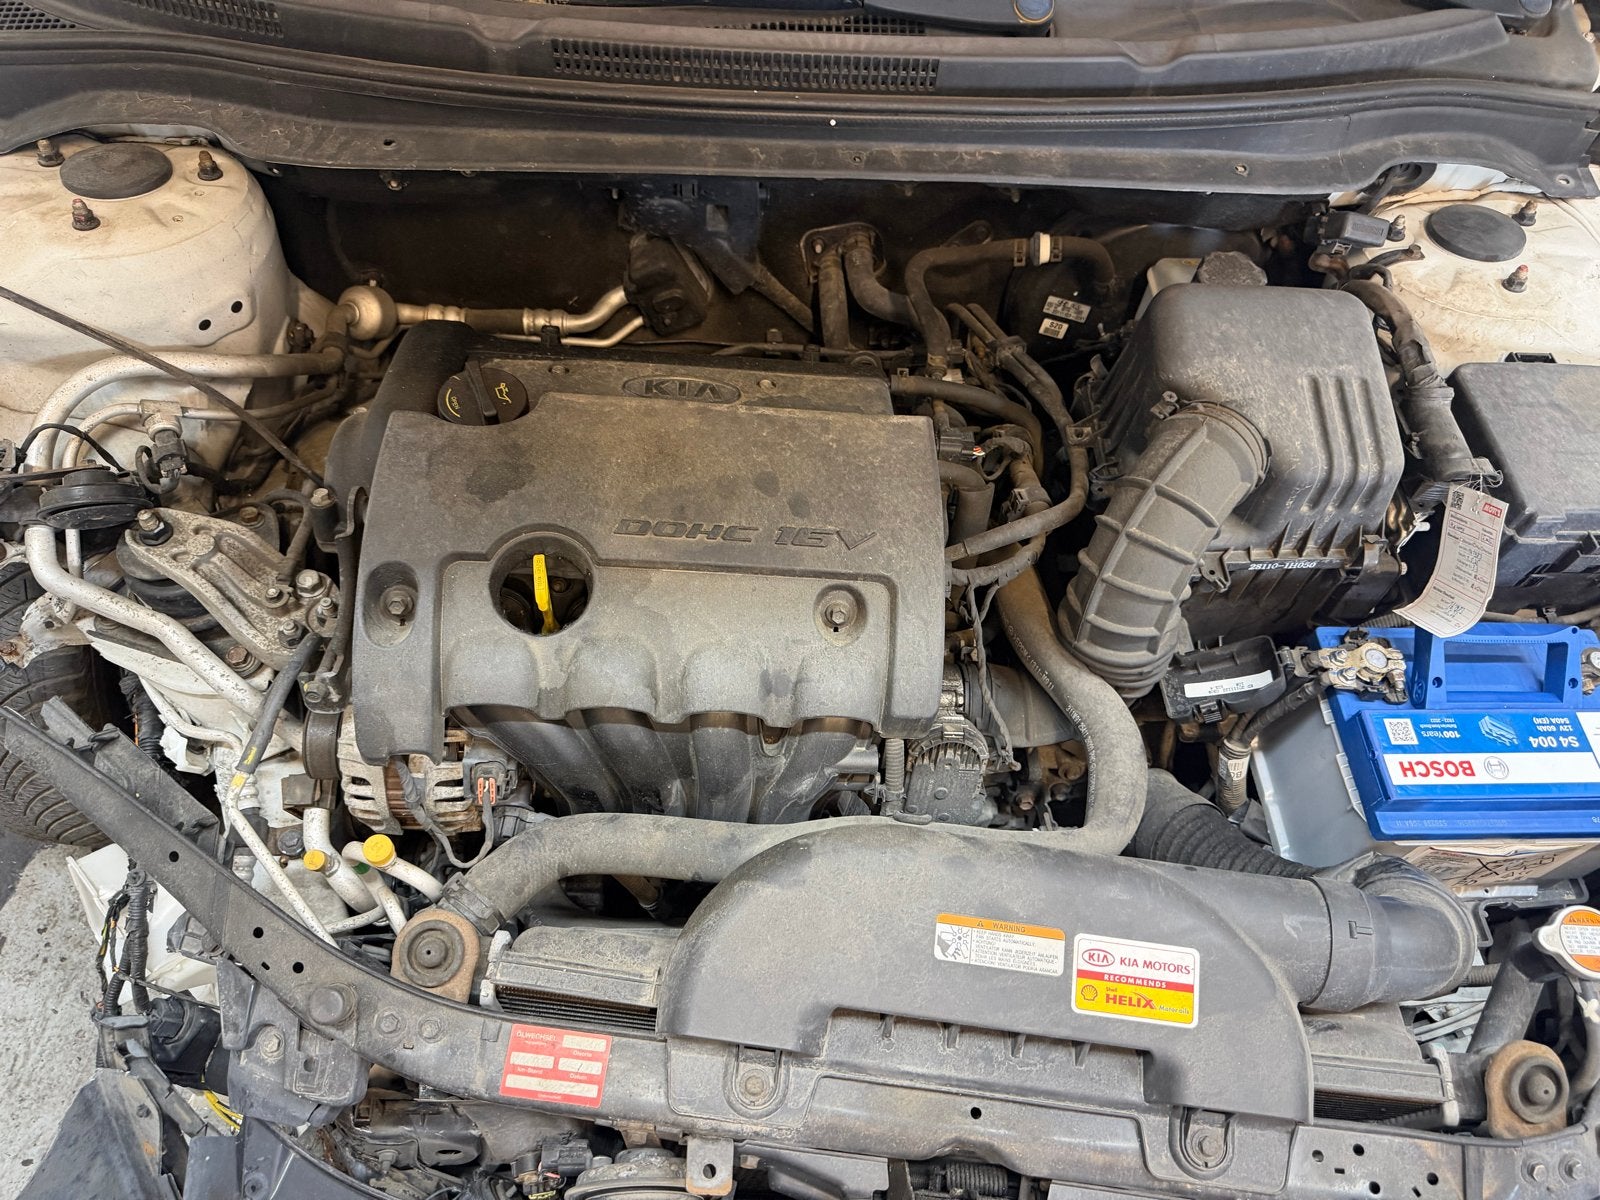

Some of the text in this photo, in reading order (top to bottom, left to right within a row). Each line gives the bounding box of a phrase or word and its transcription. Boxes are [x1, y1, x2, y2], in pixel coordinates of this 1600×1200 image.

[643, 378, 724, 400] KIA
[450, 396, 460, 410] OPEN
[613, 518, 878, 551] DOHC 16V
[1248, 562, 1317, 571] 28110-1H050
[1421, 730, 1461, 739] 100 Years
[1528, 735, 1580, 748] S4 004
[1398, 760, 1476, 778] BOSCH
[992, 921, 1026, 933] WARNING
[1088, 952, 1110, 964] KIA
[1119, 956, 1191, 975] KIA MOTORS
[1103, 973, 1168, 989] RECOMMENDS
[1105, 993, 1158, 1010] HELIX
